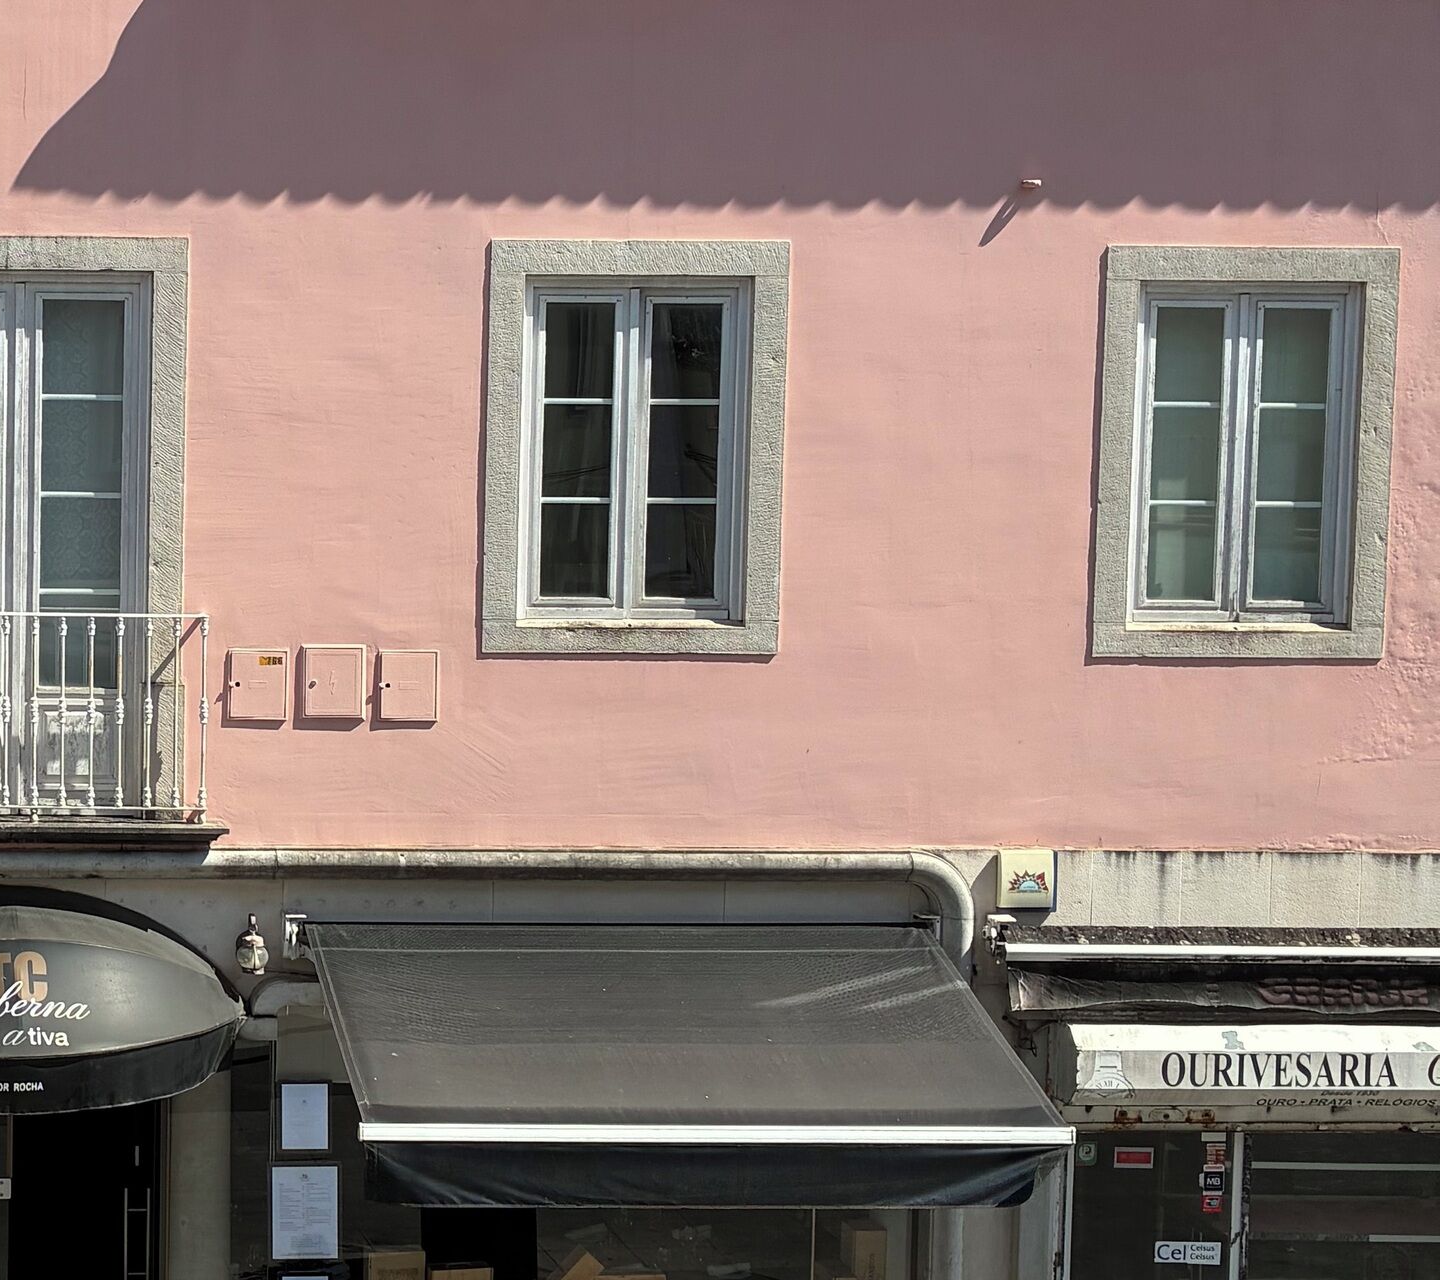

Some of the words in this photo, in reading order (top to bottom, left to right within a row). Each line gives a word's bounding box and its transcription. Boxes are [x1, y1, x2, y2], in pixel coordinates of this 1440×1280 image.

[1161, 1052, 1398, 1088] OURIVESARIA
[13, 1081, 44, 1092] ROCHA
[1256, 1098, 1297, 1106] OURO
[1309, 1098, 1353, 1106] PRATA
[1364, 1096, 1437, 1108] RELÓGIOS
